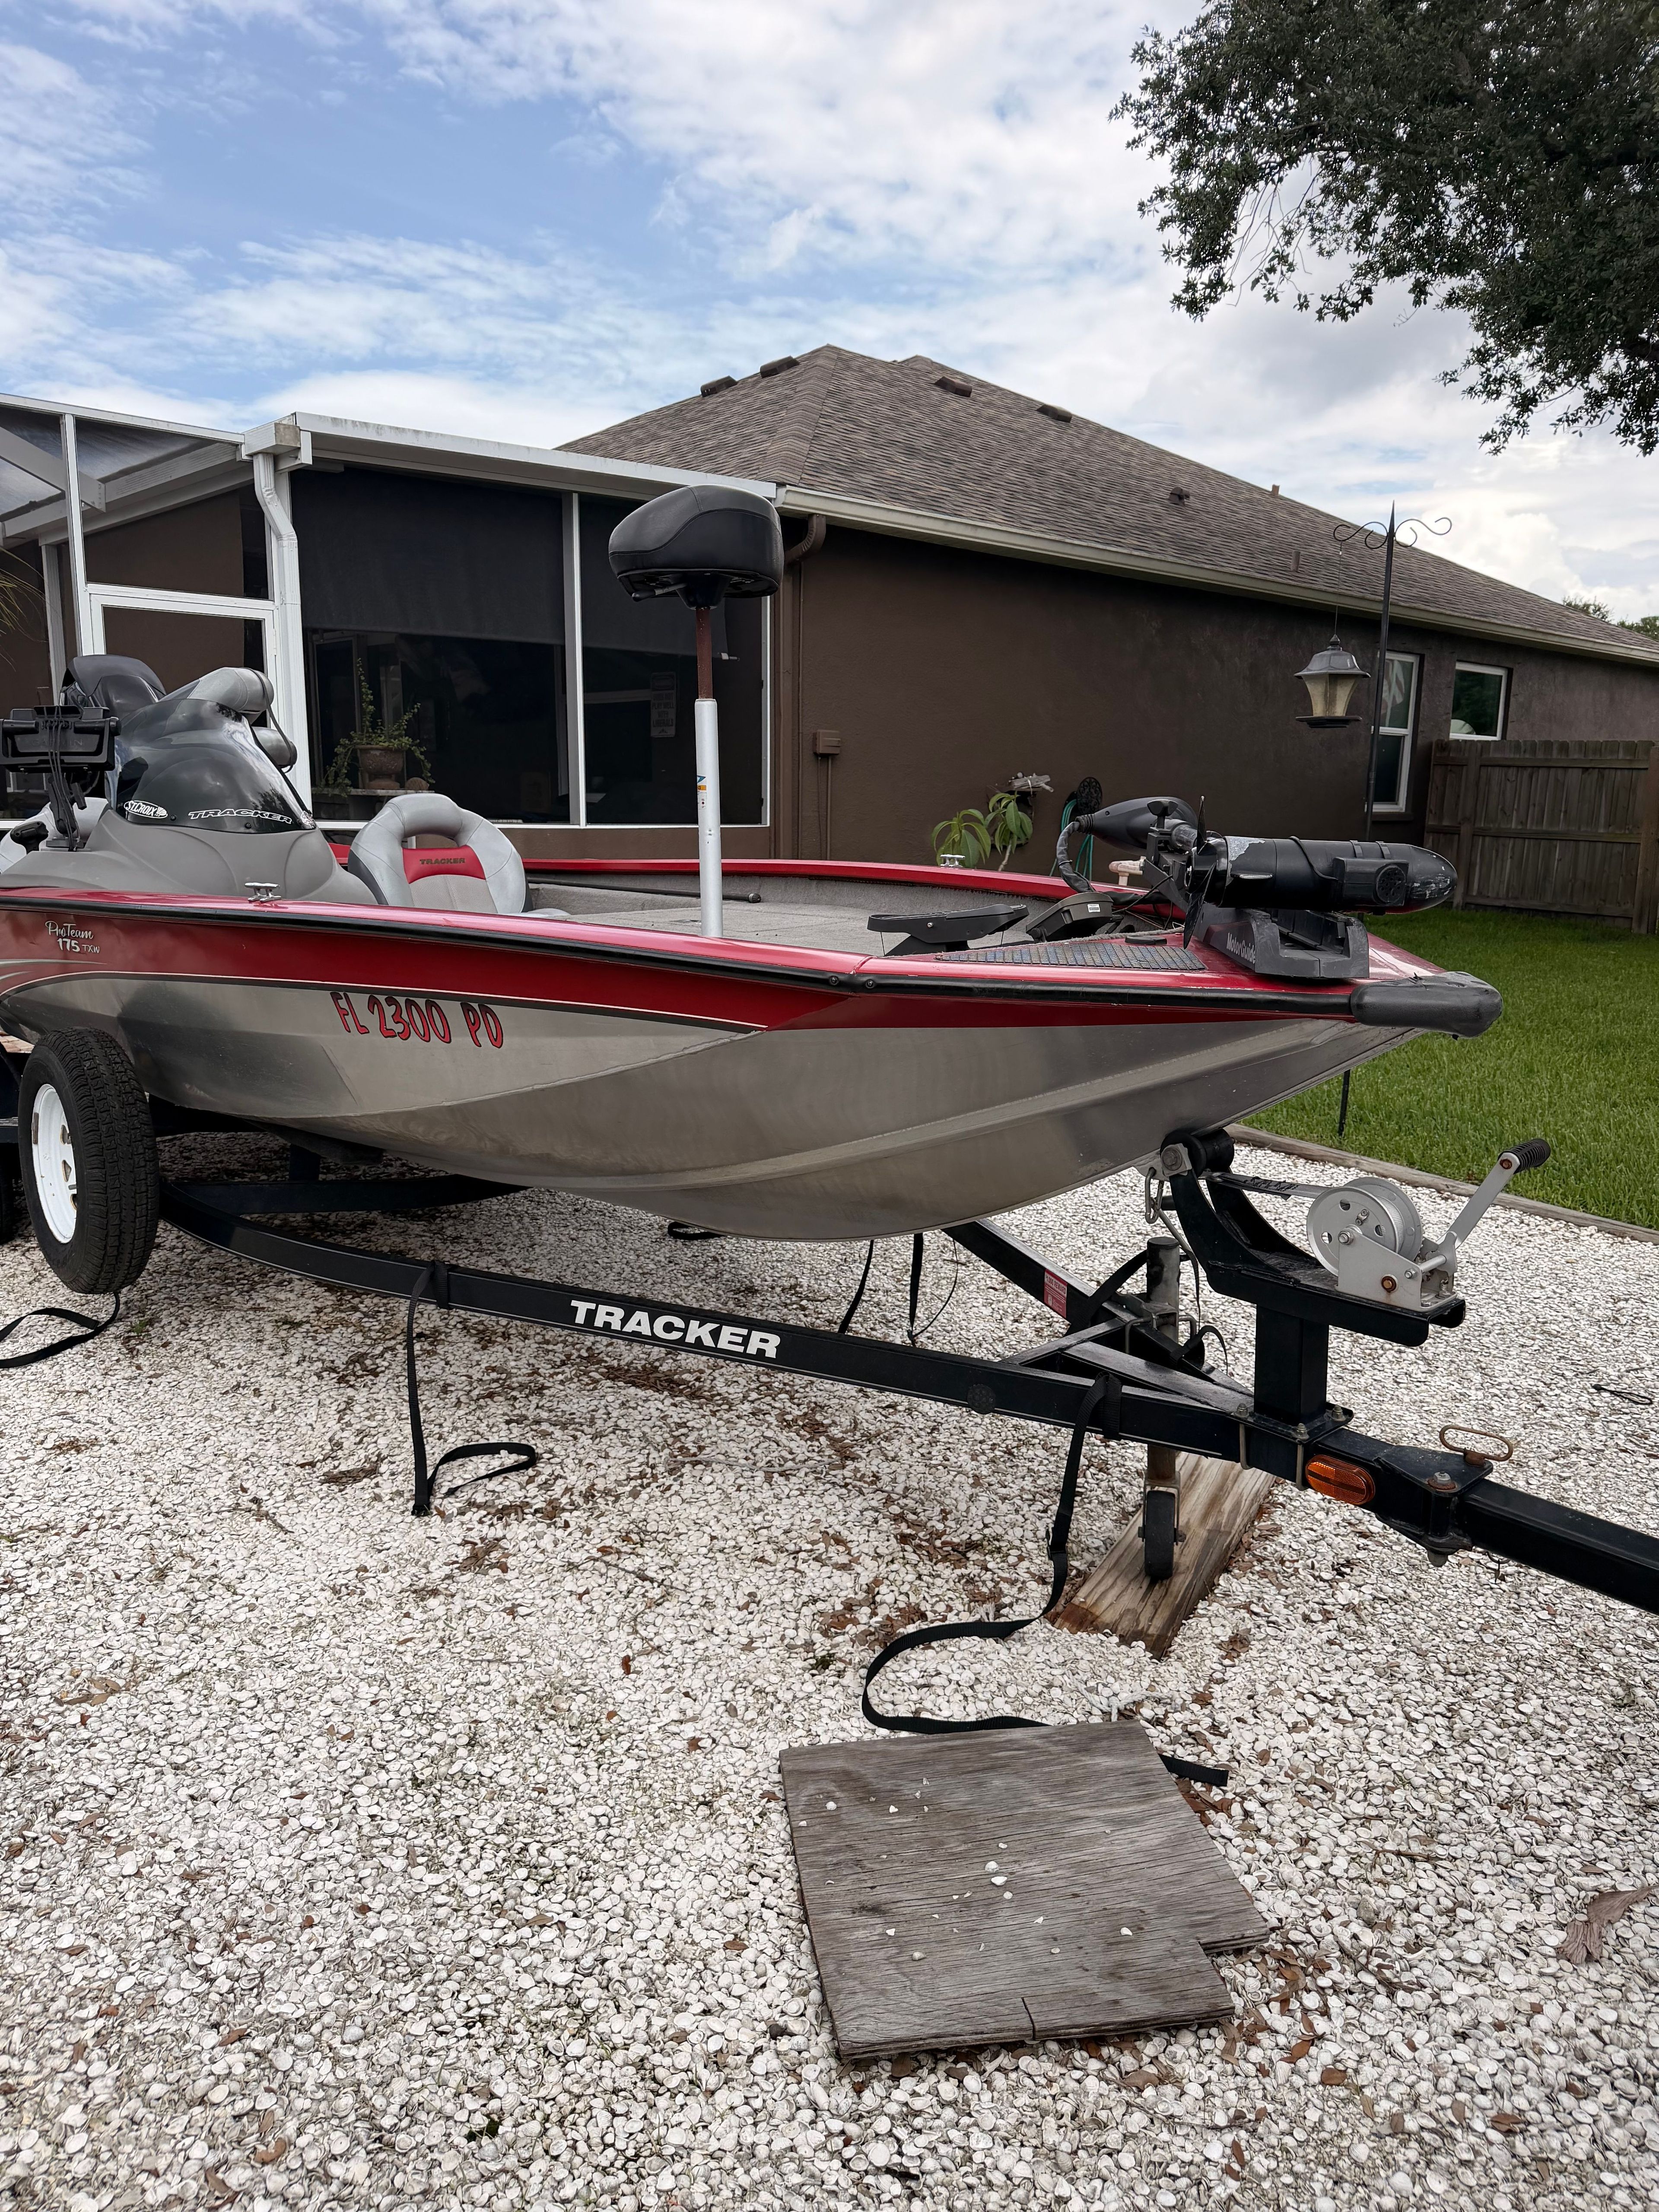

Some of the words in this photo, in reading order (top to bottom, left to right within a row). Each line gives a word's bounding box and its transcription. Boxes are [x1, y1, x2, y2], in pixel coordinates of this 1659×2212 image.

[188, 809, 292, 824] TRACKER
[45, 921, 93, 939] ProTeam
[57, 938, 80, 952] 175
[82, 944, 100, 953] TXW
[1227, 932, 1255, 964] MotorGuide
[331, 992, 370, 1034] FL
[367, 995, 451, 1044] 2300
[460, 1001, 503, 1049] PD
[570, 1300, 781, 1359] TRACKER
